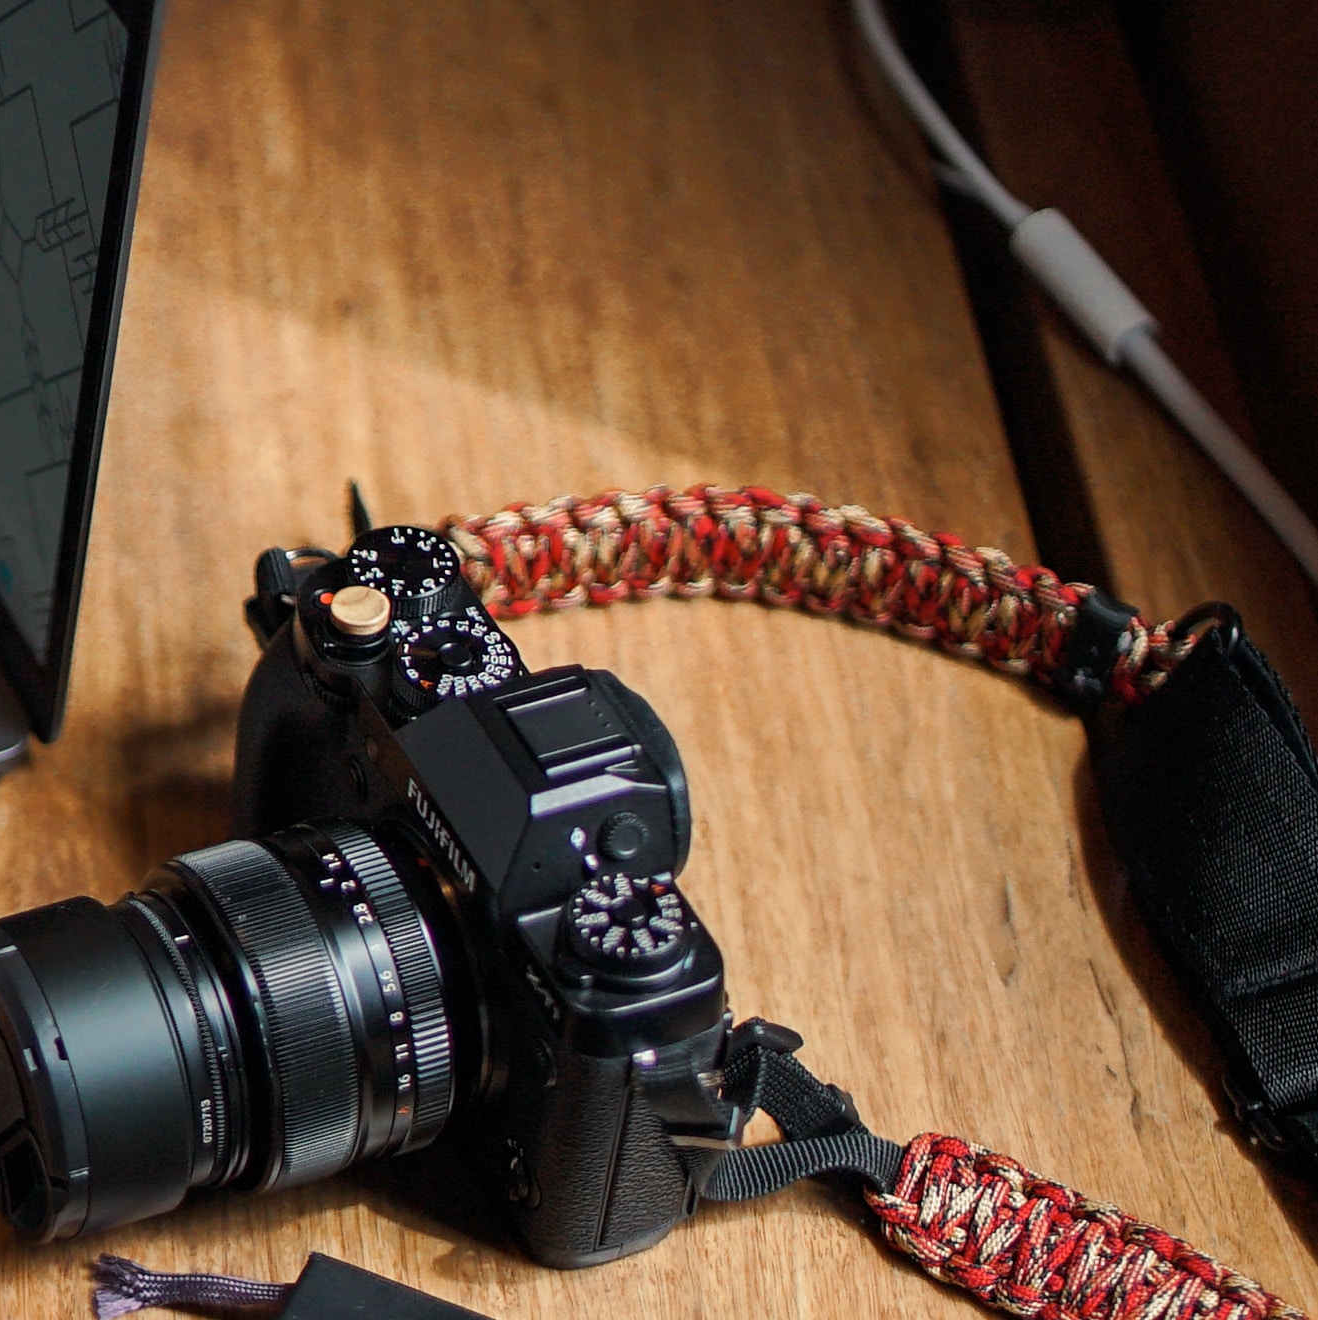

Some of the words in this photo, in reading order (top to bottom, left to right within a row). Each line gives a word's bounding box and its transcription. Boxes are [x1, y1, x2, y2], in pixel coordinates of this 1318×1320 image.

[456, 620, 469, 632] 15
[471, 623, 487, 637] 30
[407, 632, 419, 643] 2
[484, 632, 501, 644] 60
[487, 642, 511, 655] 125
[401, 656, 412, 667] T
[406, 669, 419, 679] B
[485, 664, 511, 678] 250
[407, 777, 476, 893] FUJIFILM
[322, 853, 342, 868] 1.4
[340, 880, 356, 889] 2
[353, 903, 373, 924] 2.8
[379, 970, 397, 993] 5.6
[389, 1011, 405, 1022] 8
[395, 1043, 409, 1060] 11
[398, 1073, 412, 1090] 16
